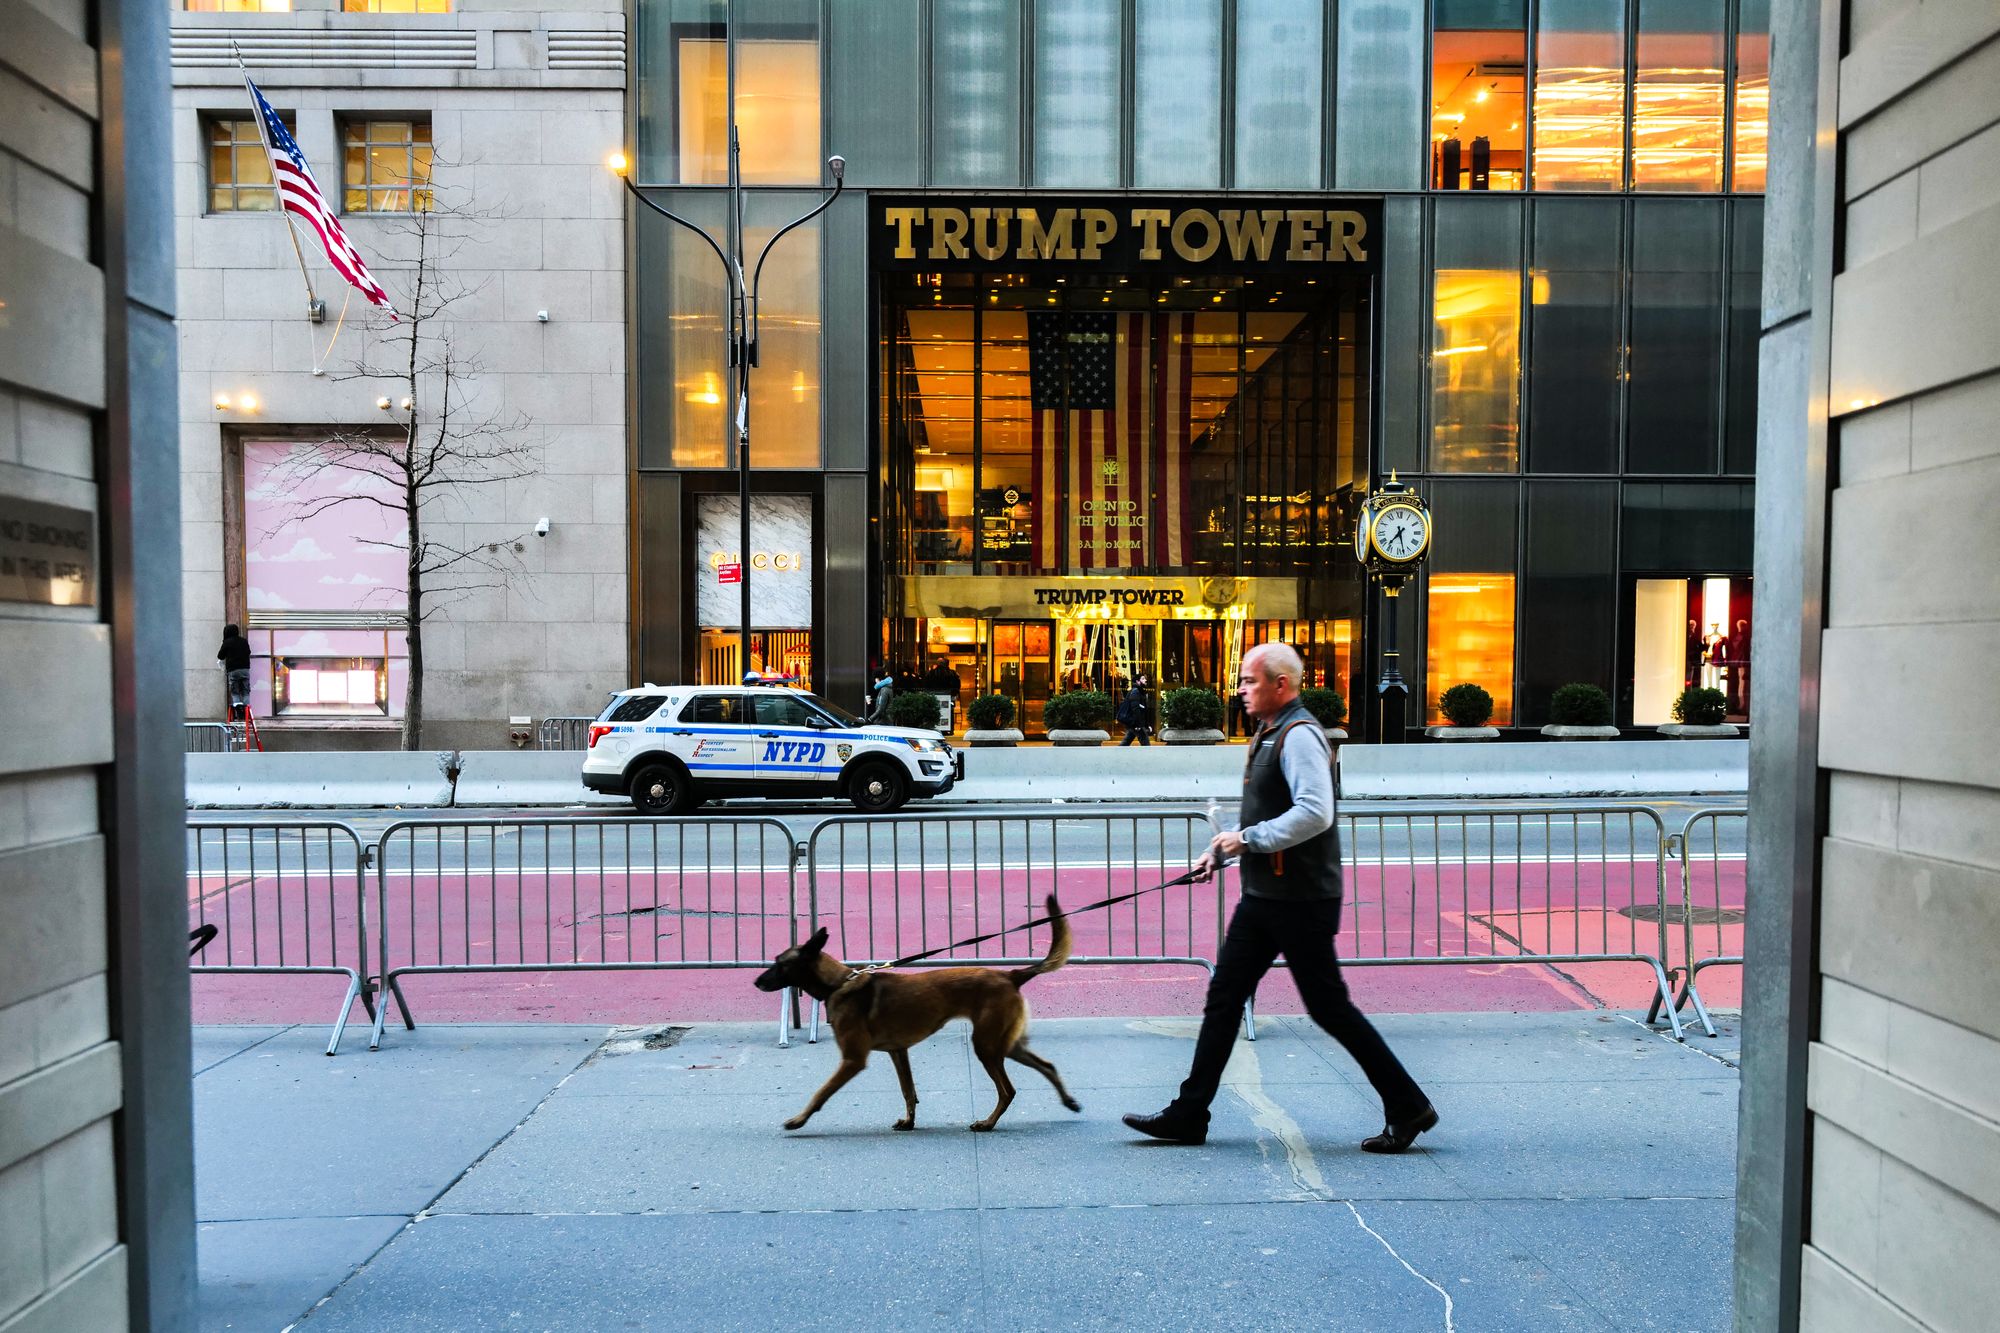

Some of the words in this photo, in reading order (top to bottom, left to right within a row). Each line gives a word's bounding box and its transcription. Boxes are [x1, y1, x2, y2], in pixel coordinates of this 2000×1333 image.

[885, 207, 1118, 261] TRUMP
[1131, 208, 1368, 263] TOWER
[1082, 500, 1117, 511] OPEN
[1119, 501, 1136, 511] TO
[1073, 515, 1099, 526] THE
[1102, 515, 1147, 526] PUBLIC
[711, 554, 800, 570] GCCI
[1034, 589, 1107, 605] TRUMP
[1110, 589, 1184, 605] TOWER
[863, 734, 889, 742] POLICE
[762, 741, 826, 763] NYPD
